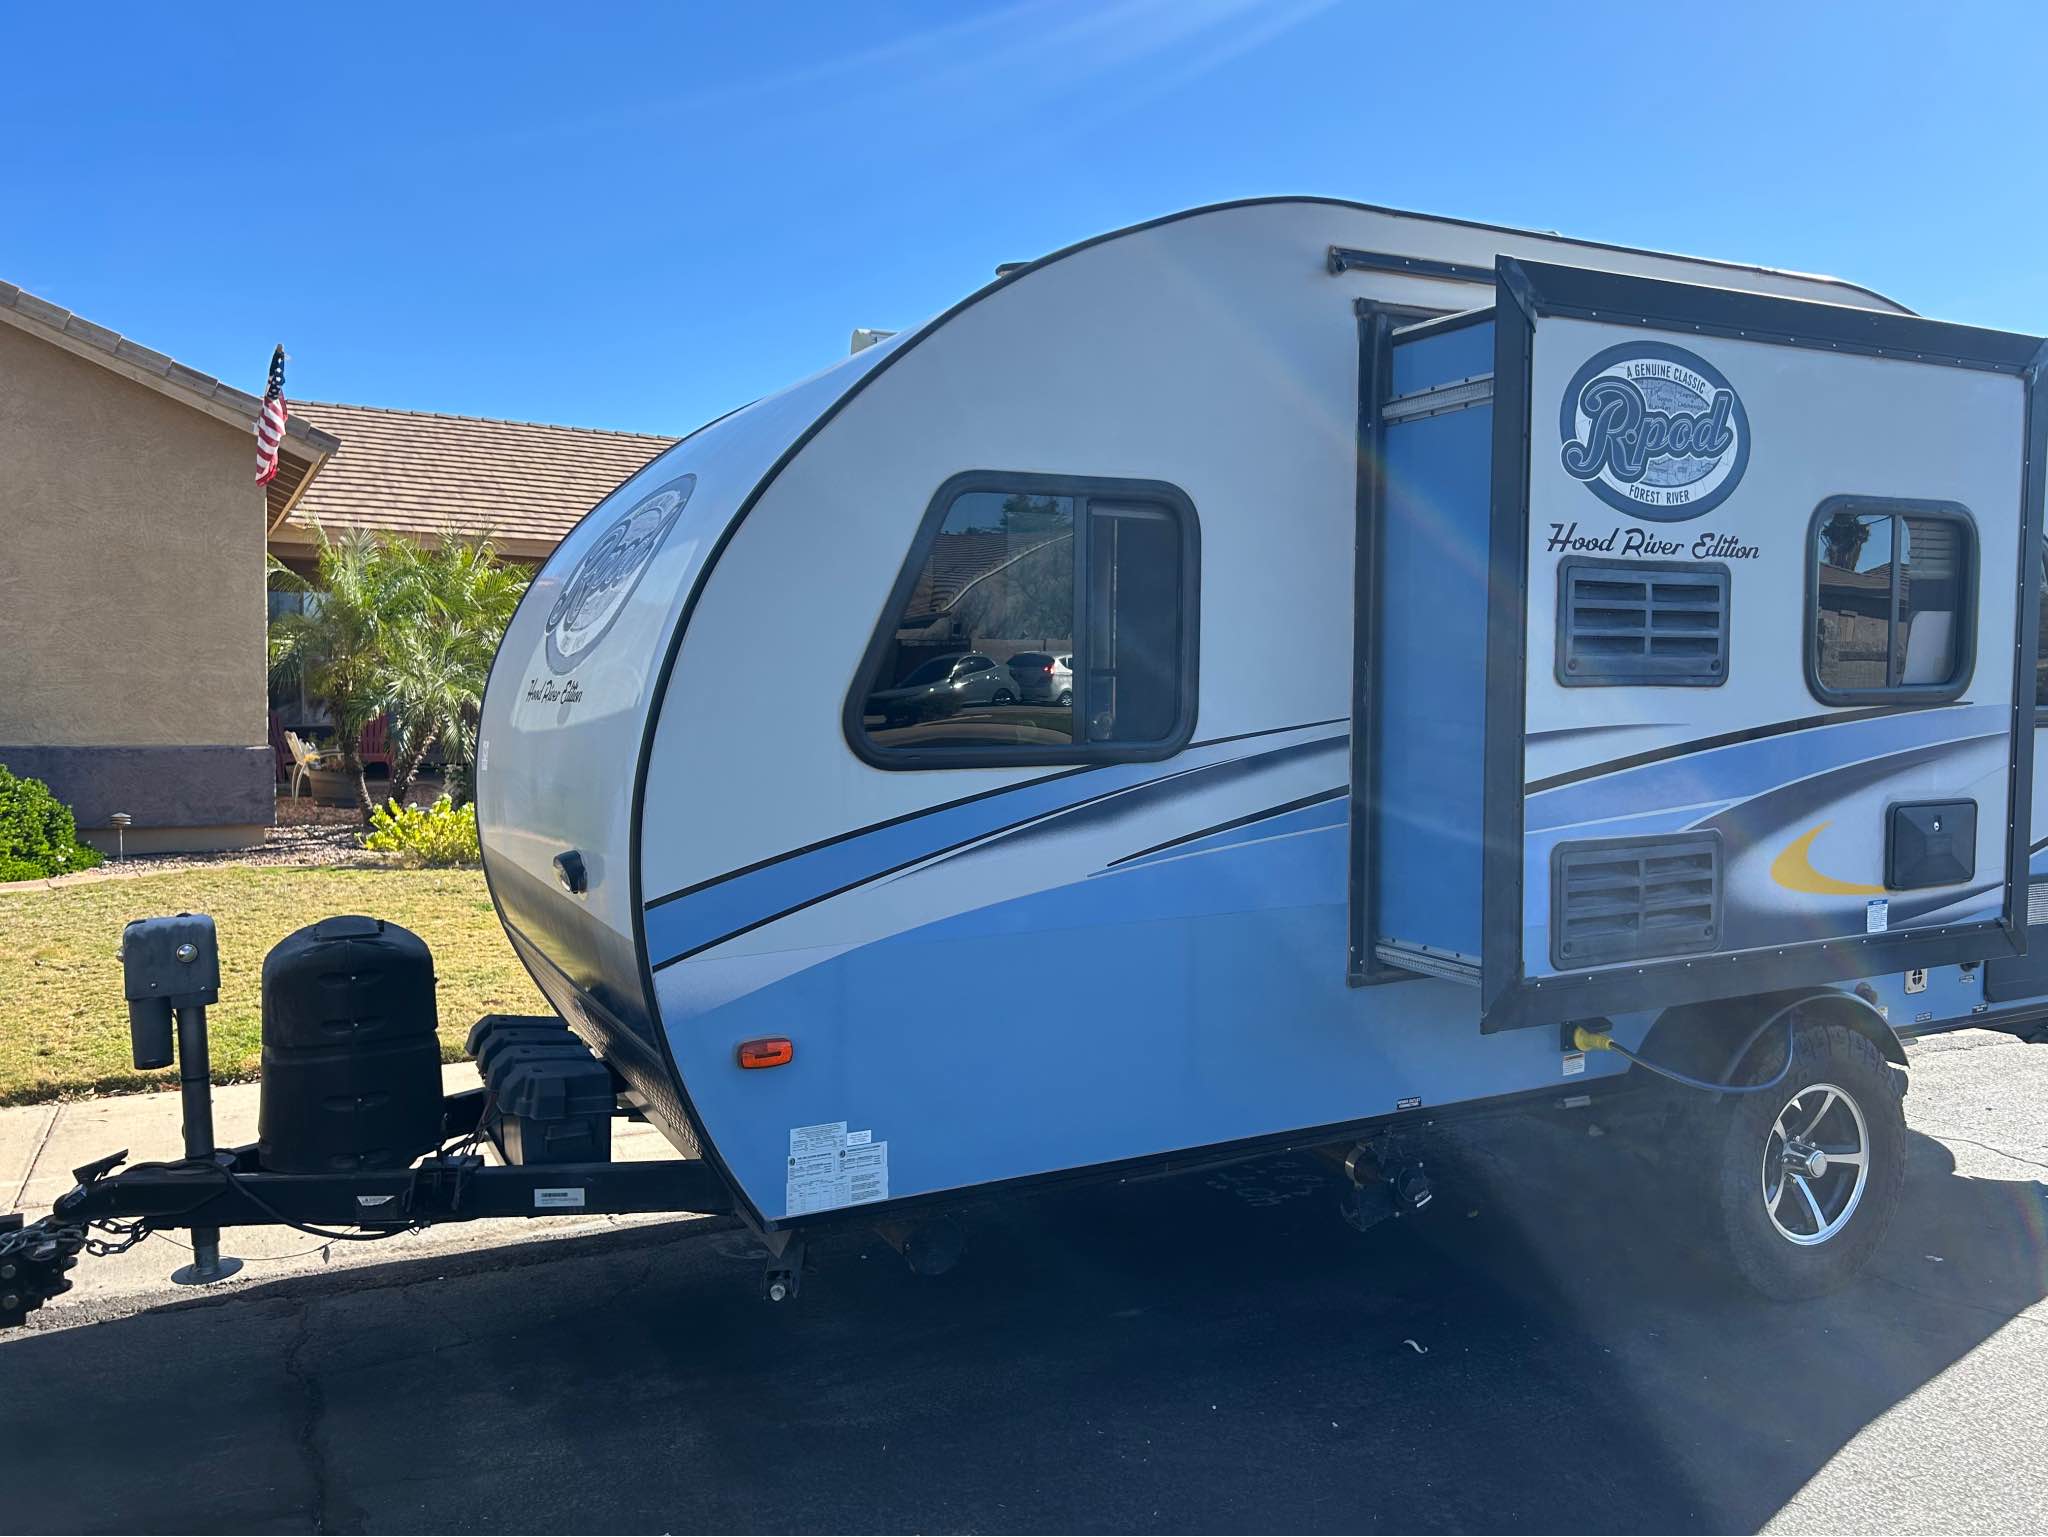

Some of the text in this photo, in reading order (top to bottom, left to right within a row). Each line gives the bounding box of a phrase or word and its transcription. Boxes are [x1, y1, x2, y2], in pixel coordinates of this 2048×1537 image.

[1626, 363, 1706, 394] A GENUINE CLASSIC
[1629, 484, 1690, 504] FOREST RIVER
[1547, 522, 1760, 560] Hood River Edition
